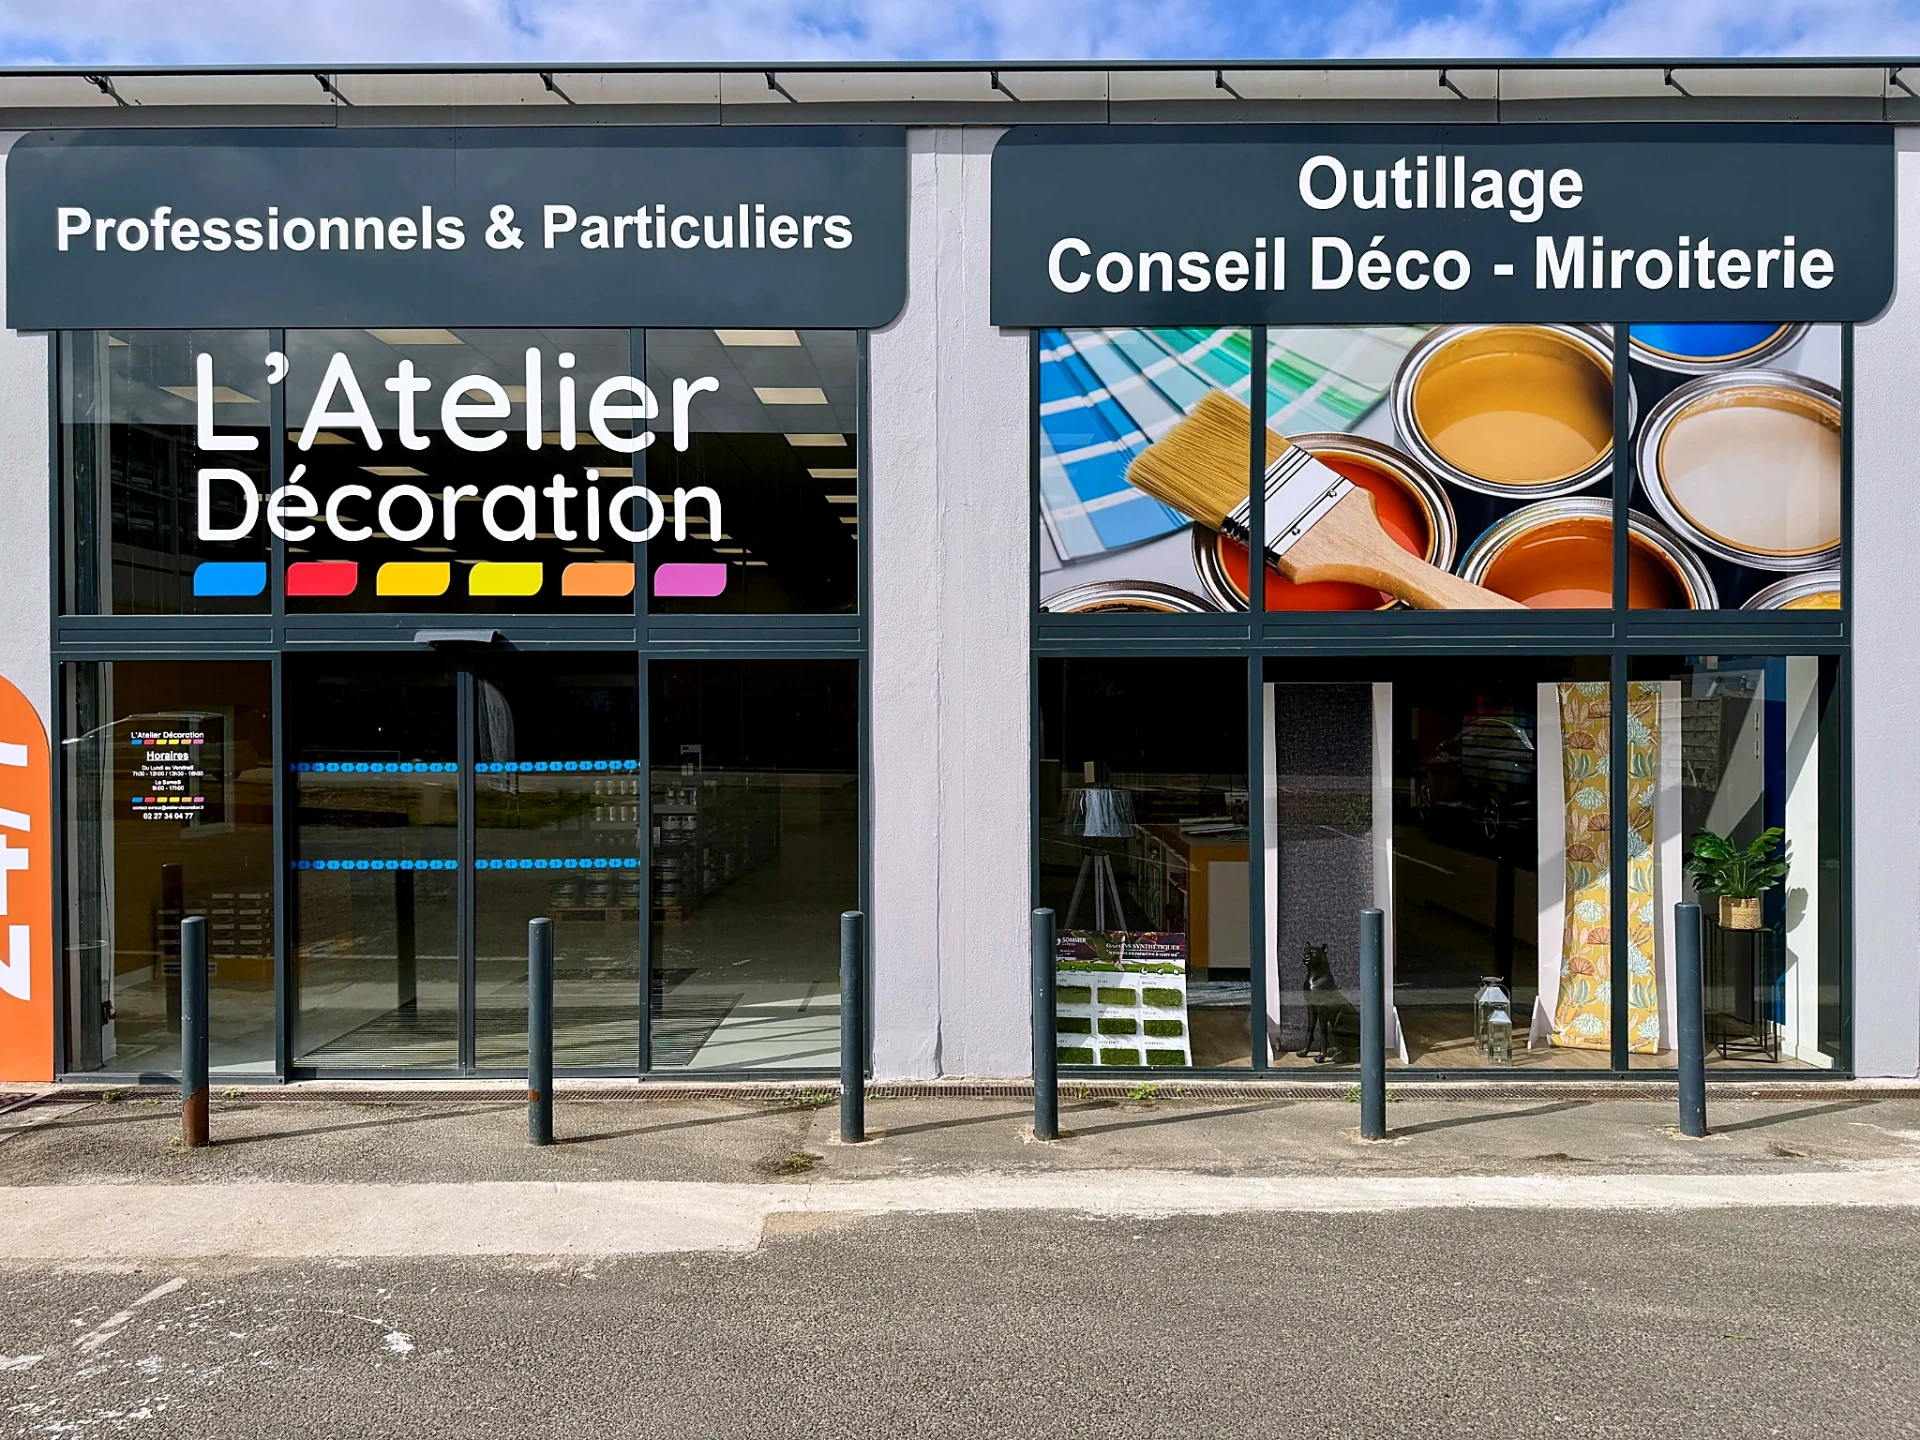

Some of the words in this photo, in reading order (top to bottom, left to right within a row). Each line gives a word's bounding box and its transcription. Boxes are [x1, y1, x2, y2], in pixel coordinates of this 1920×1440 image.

[1298, 155, 1583, 223] Outillage
[57, 205, 466, 253] Professionnels
[485, 204, 525, 250] &
[543, 203, 853, 250] Particuliers
[1048, 236, 1286, 293] Conseil
[1311, 234, 1471, 291] Déco
[1494, 264, 1514, 276] -
[1536, 235, 1834, 290] Miroiterie
[196, 347, 719, 453] L'Atelier
[198, 463, 722, 542] Décoration
[146, 751, 189, 761] Horaires
